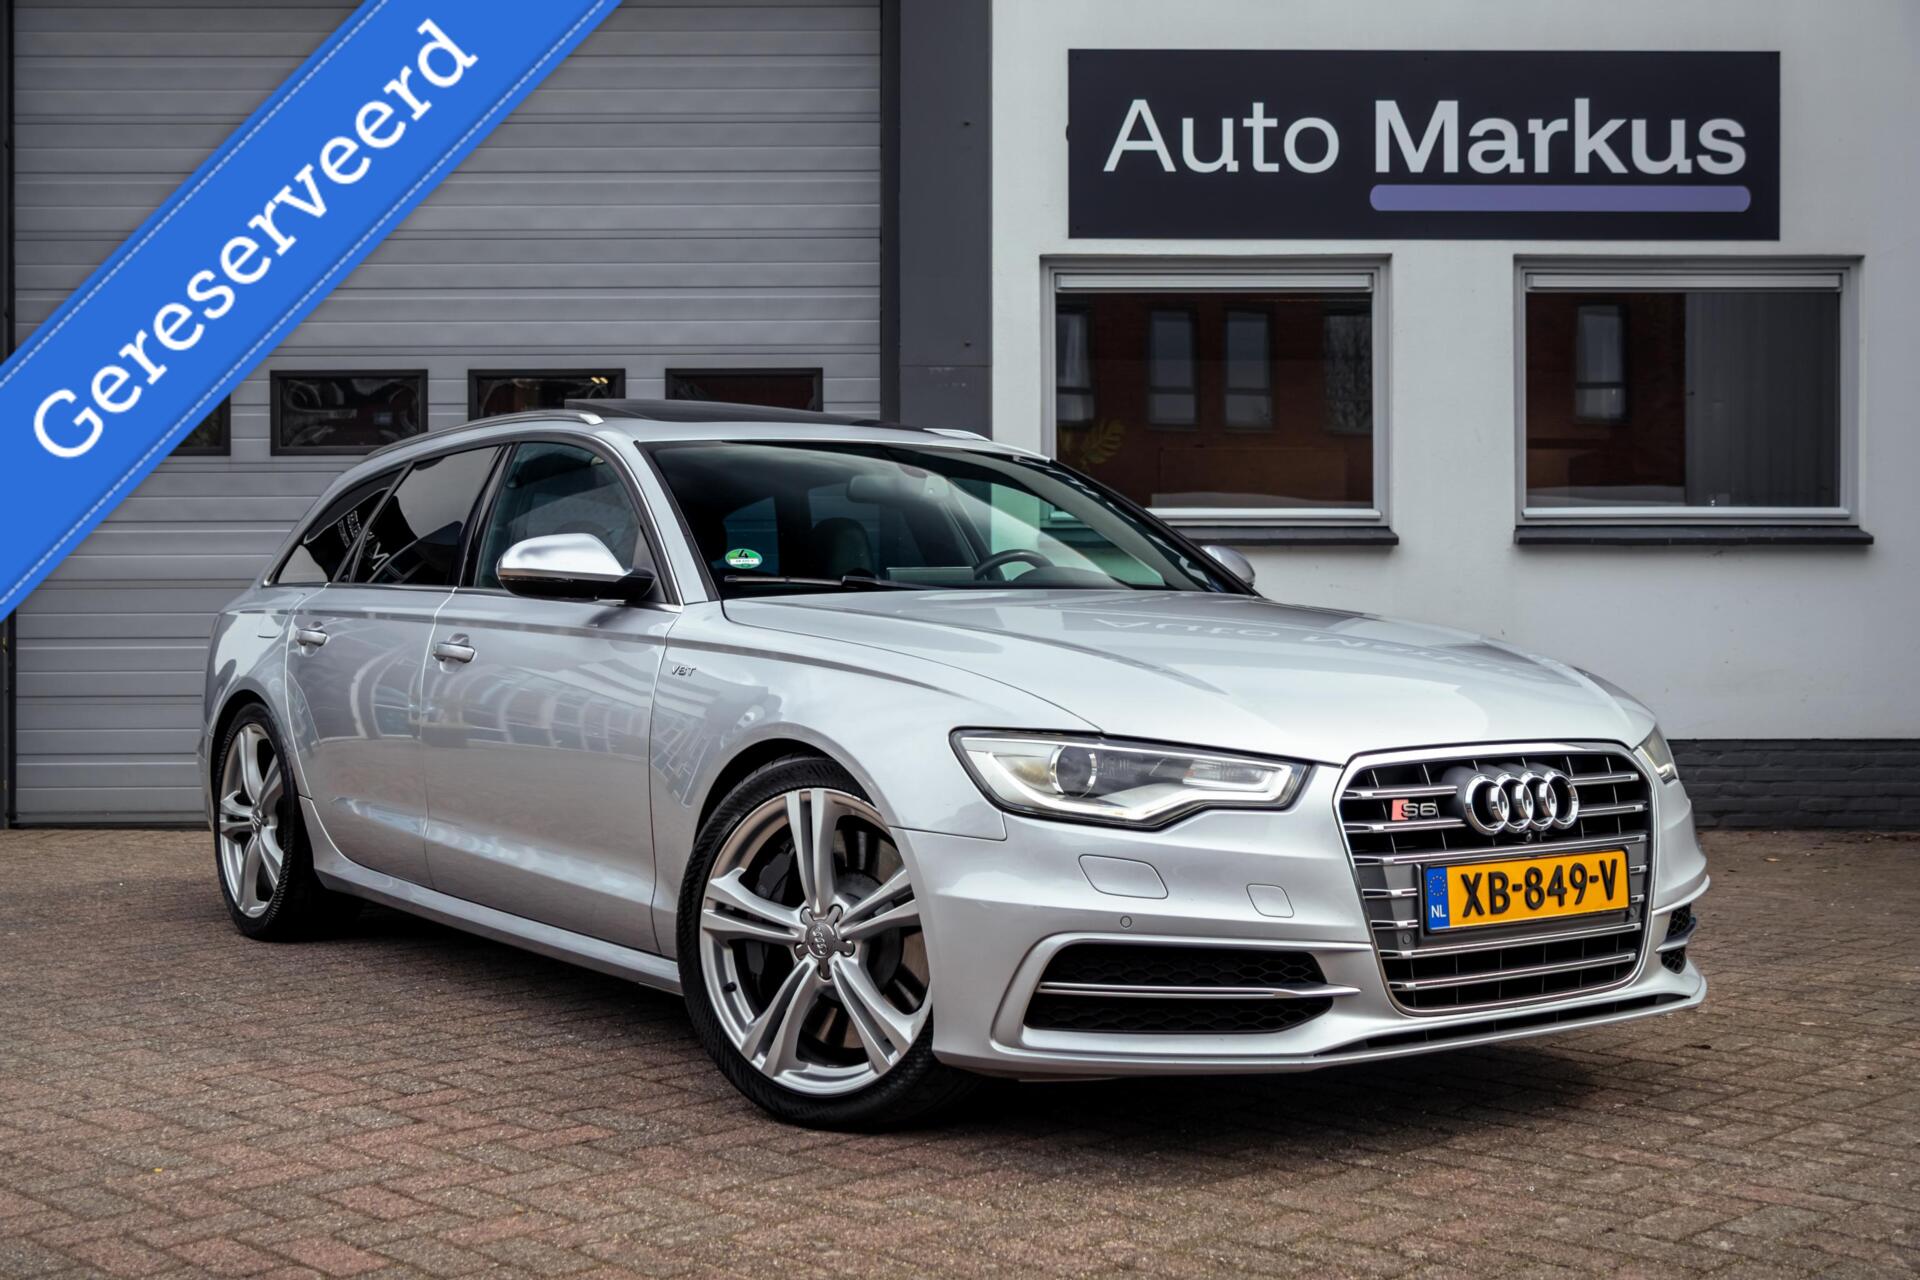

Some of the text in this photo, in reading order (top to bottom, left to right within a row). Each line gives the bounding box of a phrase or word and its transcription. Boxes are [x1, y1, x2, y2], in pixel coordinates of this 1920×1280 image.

[1103, 98, 1747, 175] Auto Markus
[738, 549, 749, 558] 4
[1401, 803, 1437, 818] S6
[1461, 859, 1617, 917] XB-849-V
[1431, 905, 1446, 918] NL
